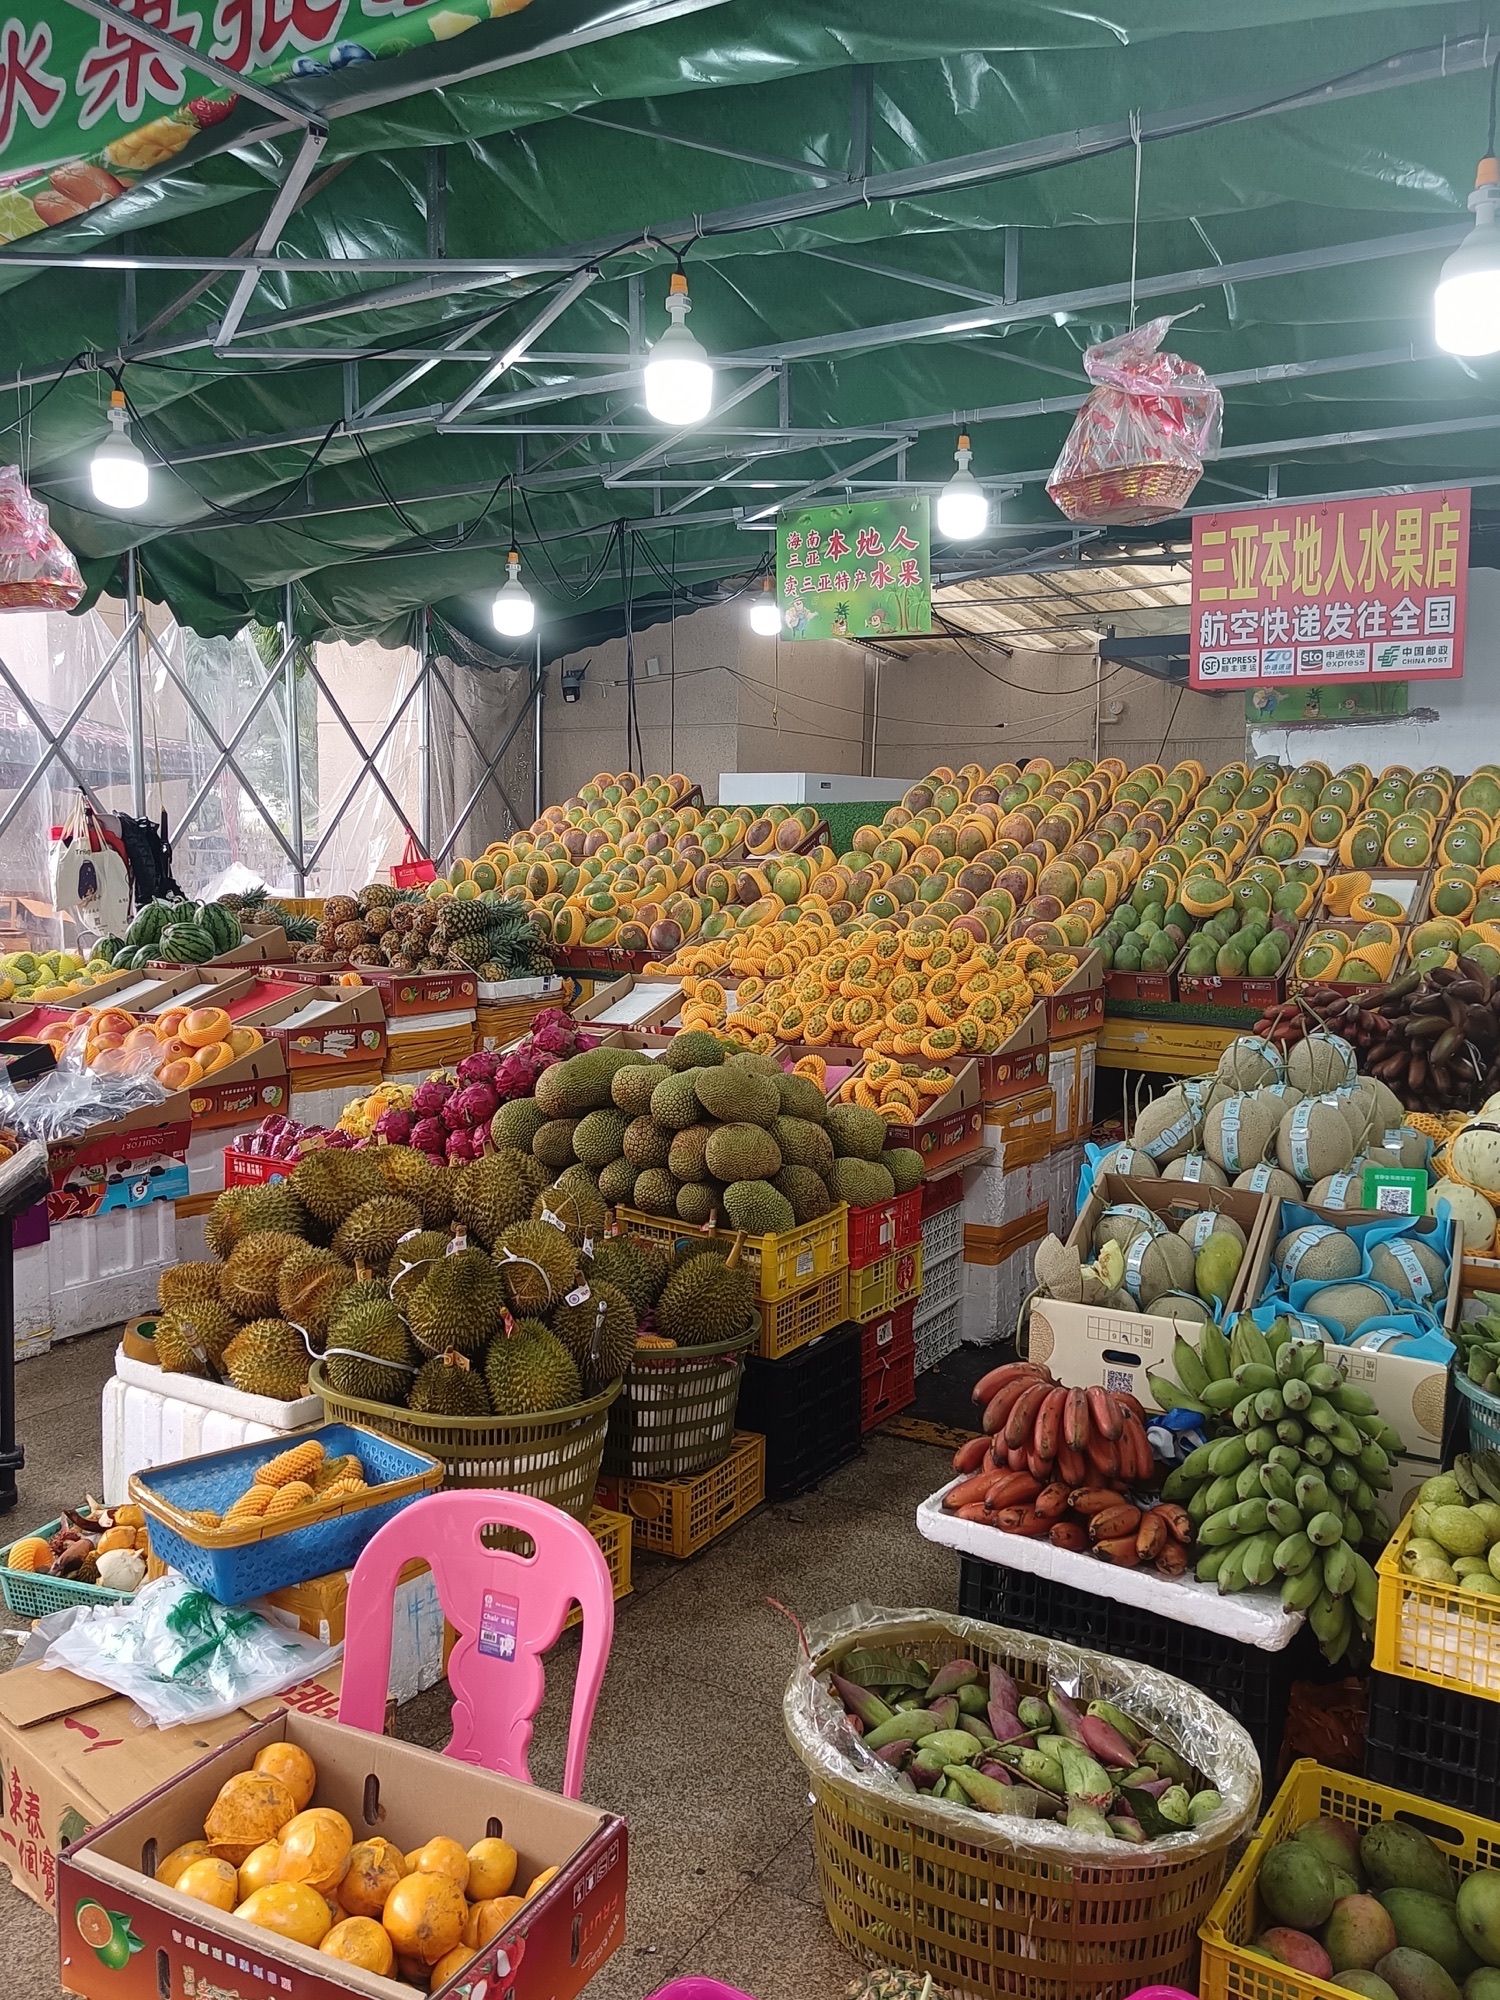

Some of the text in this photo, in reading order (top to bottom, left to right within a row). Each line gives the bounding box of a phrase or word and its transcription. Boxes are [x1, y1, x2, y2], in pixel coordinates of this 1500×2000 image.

[786, 527, 919, 562] 海南 本地人
[1199, 502, 1461, 602] 三亚本地人水果店
[786, 551, 821, 568] 三亚
[785, 559, 922, 597] 卖三亚特产水果
[1199, 595, 1456, 648] 航空快递发往全国
[1264, 650, 1293, 662] ZTO
[1302, 650, 1322, 661] sto
[1325, 649, 1366, 660] 申通快递
[1402, 645, 1448, 657] 中国邮政
[1204, 655, 1257, 671] SF EXPRESS
[1221, 664, 1257, 673] 顺丰速运
[1325, 659, 1365, 668] express
[80, 1167, 101, 1178] ALSU
[483, 1613, 499, 1622] Chair
